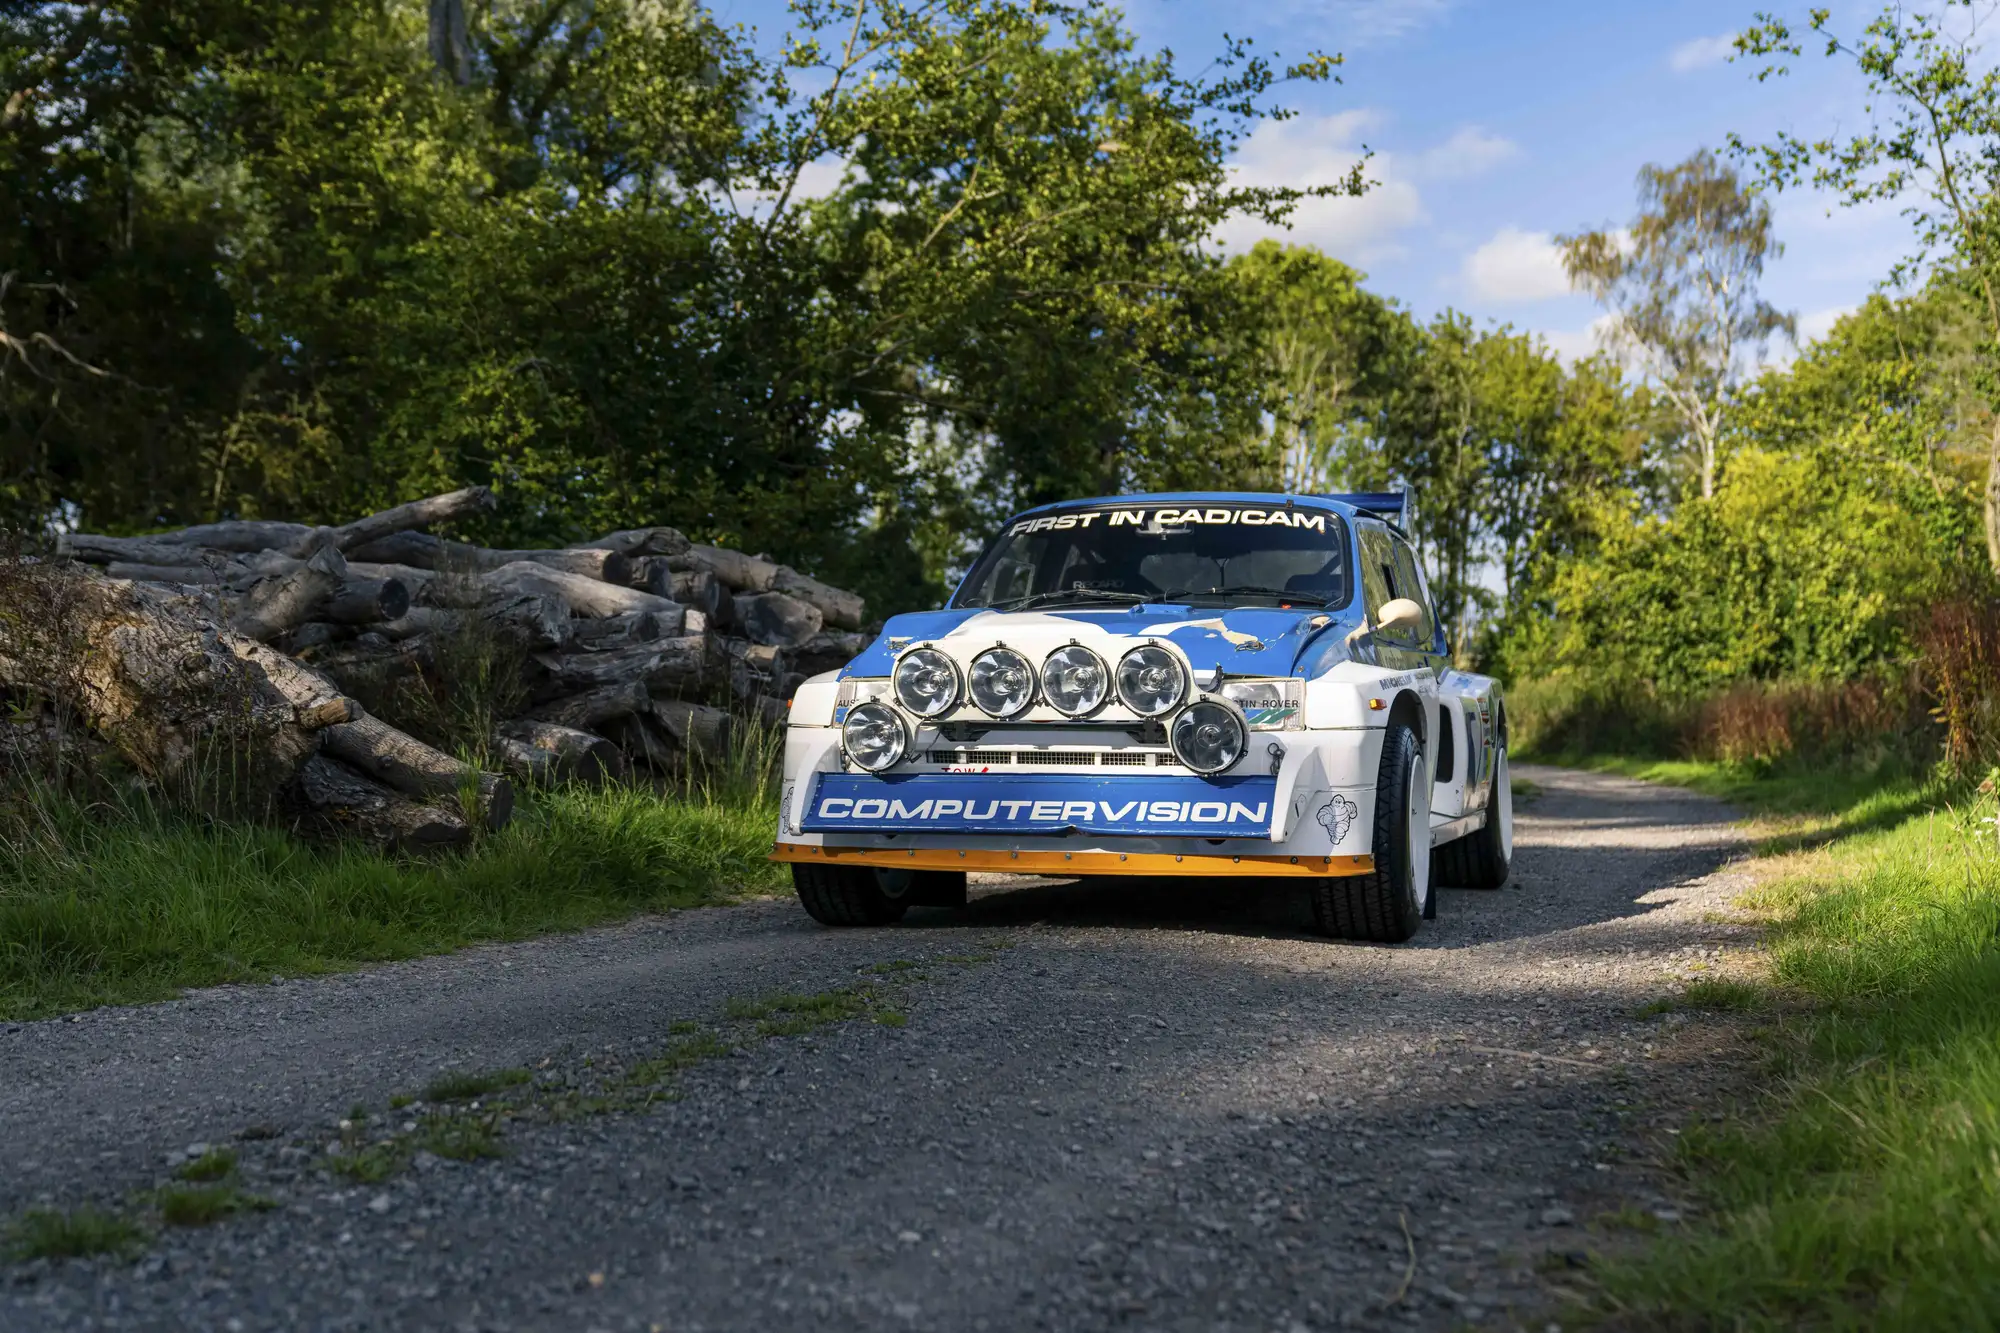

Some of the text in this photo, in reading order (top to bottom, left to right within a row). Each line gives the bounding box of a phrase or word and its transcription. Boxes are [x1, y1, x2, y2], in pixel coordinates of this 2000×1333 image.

[1008, 509, 1325, 537] FIRST IN CAD/CAM
[837, 698, 860, 708] AUS
[1262, 699, 1299, 708] ROVER
[818, 797, 1268, 823] COMPUTERVISION
